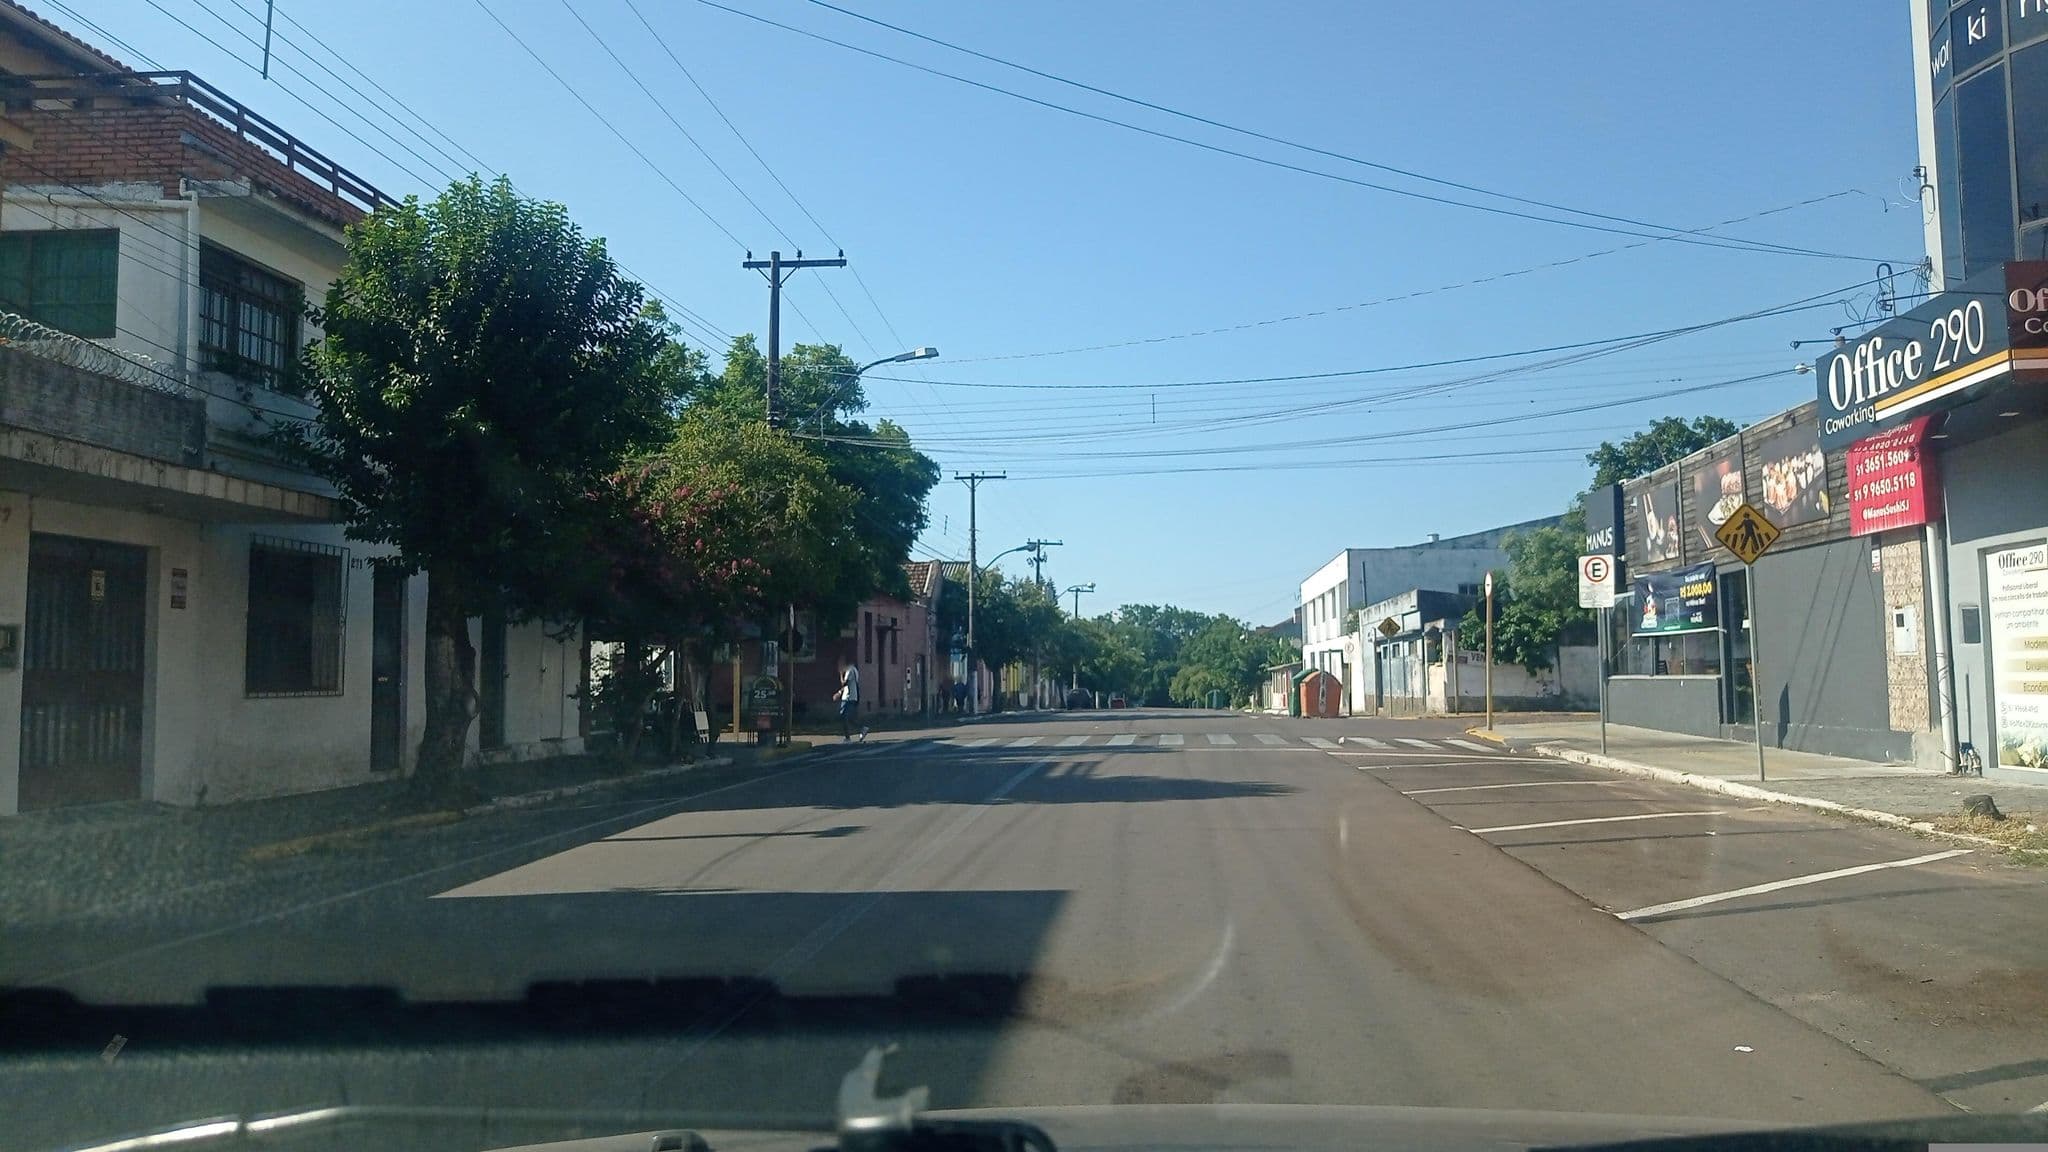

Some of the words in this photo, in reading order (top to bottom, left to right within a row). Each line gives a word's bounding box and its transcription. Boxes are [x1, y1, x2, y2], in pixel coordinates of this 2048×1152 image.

[1828, 336, 1923, 411] Office
[1930, 300, 1984, 372] 290
[1825, 405, 1876, 435] Coworking
[1586, 526, 1613, 552] MANUS
[1591, 562, 1601, 578] E
[1998, 552, 2028, 569] Office
[2029, 550, 2044, 565] 290
